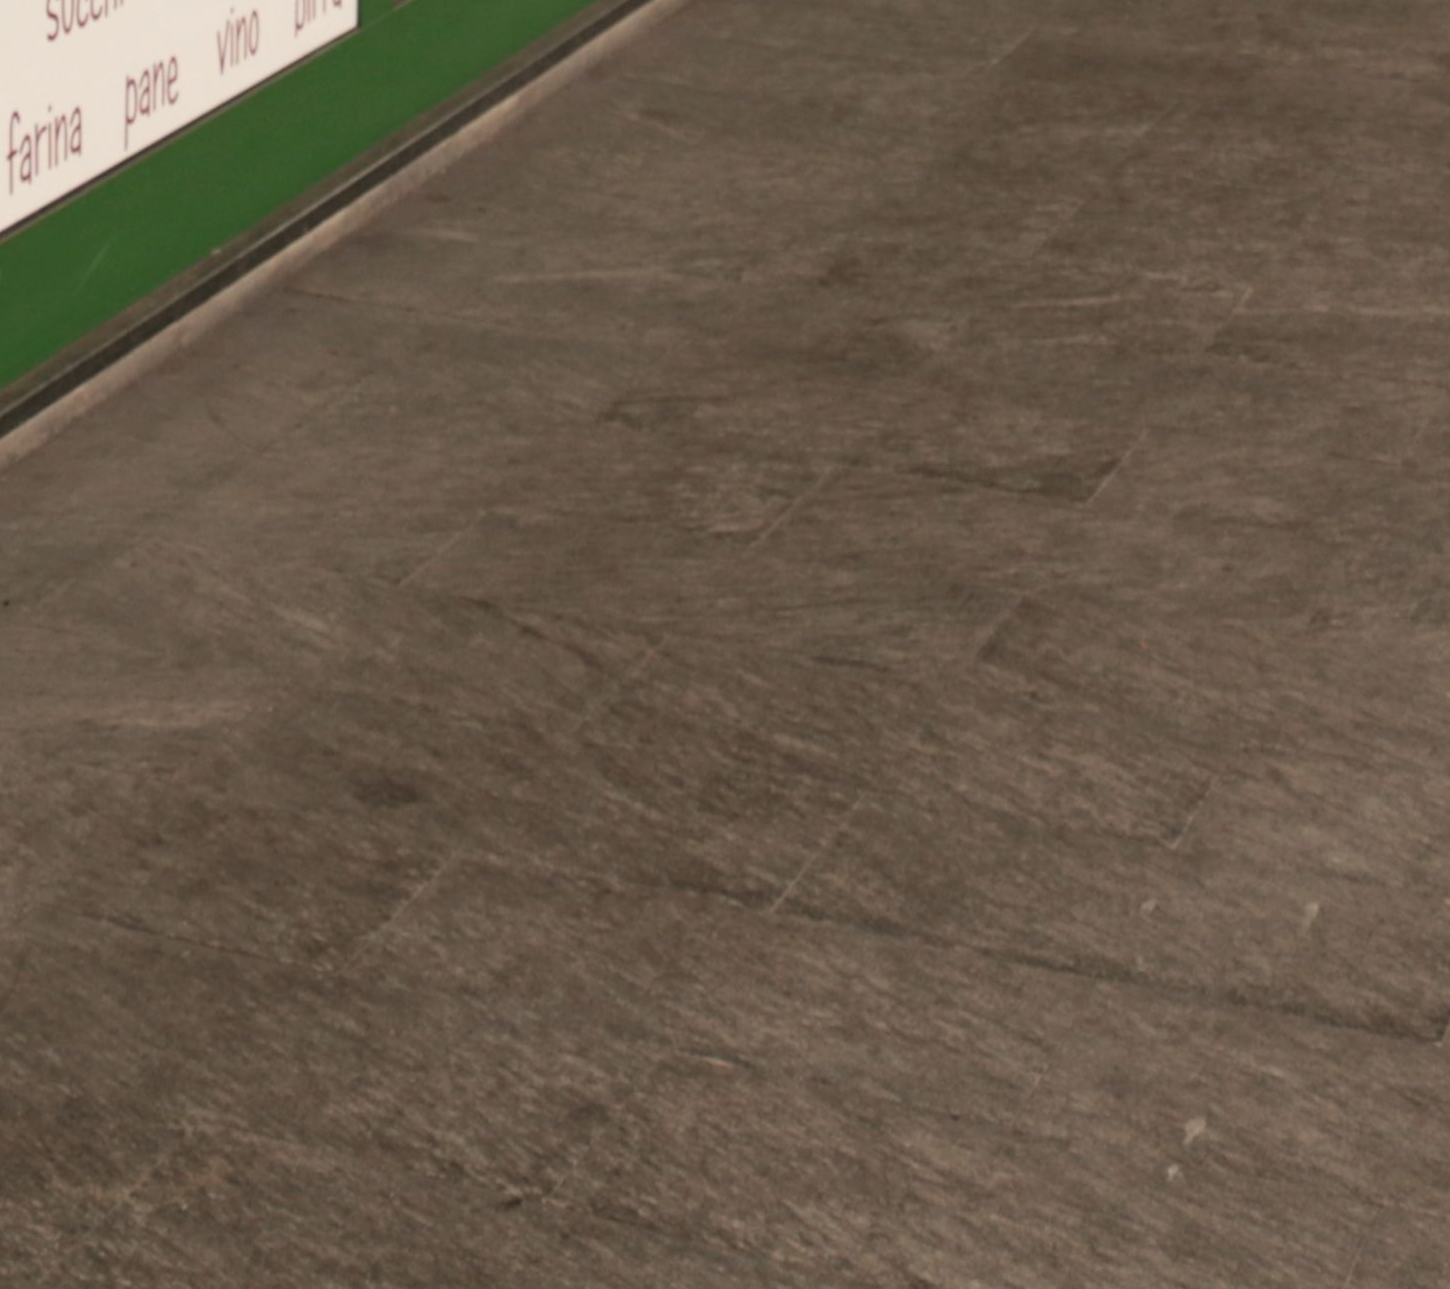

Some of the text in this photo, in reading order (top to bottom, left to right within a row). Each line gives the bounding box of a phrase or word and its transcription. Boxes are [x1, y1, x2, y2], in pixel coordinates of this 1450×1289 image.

[7, 102, 83, 194] farina
[124, 54, 179, 150] pane
[216, 5, 259, 76] vino
